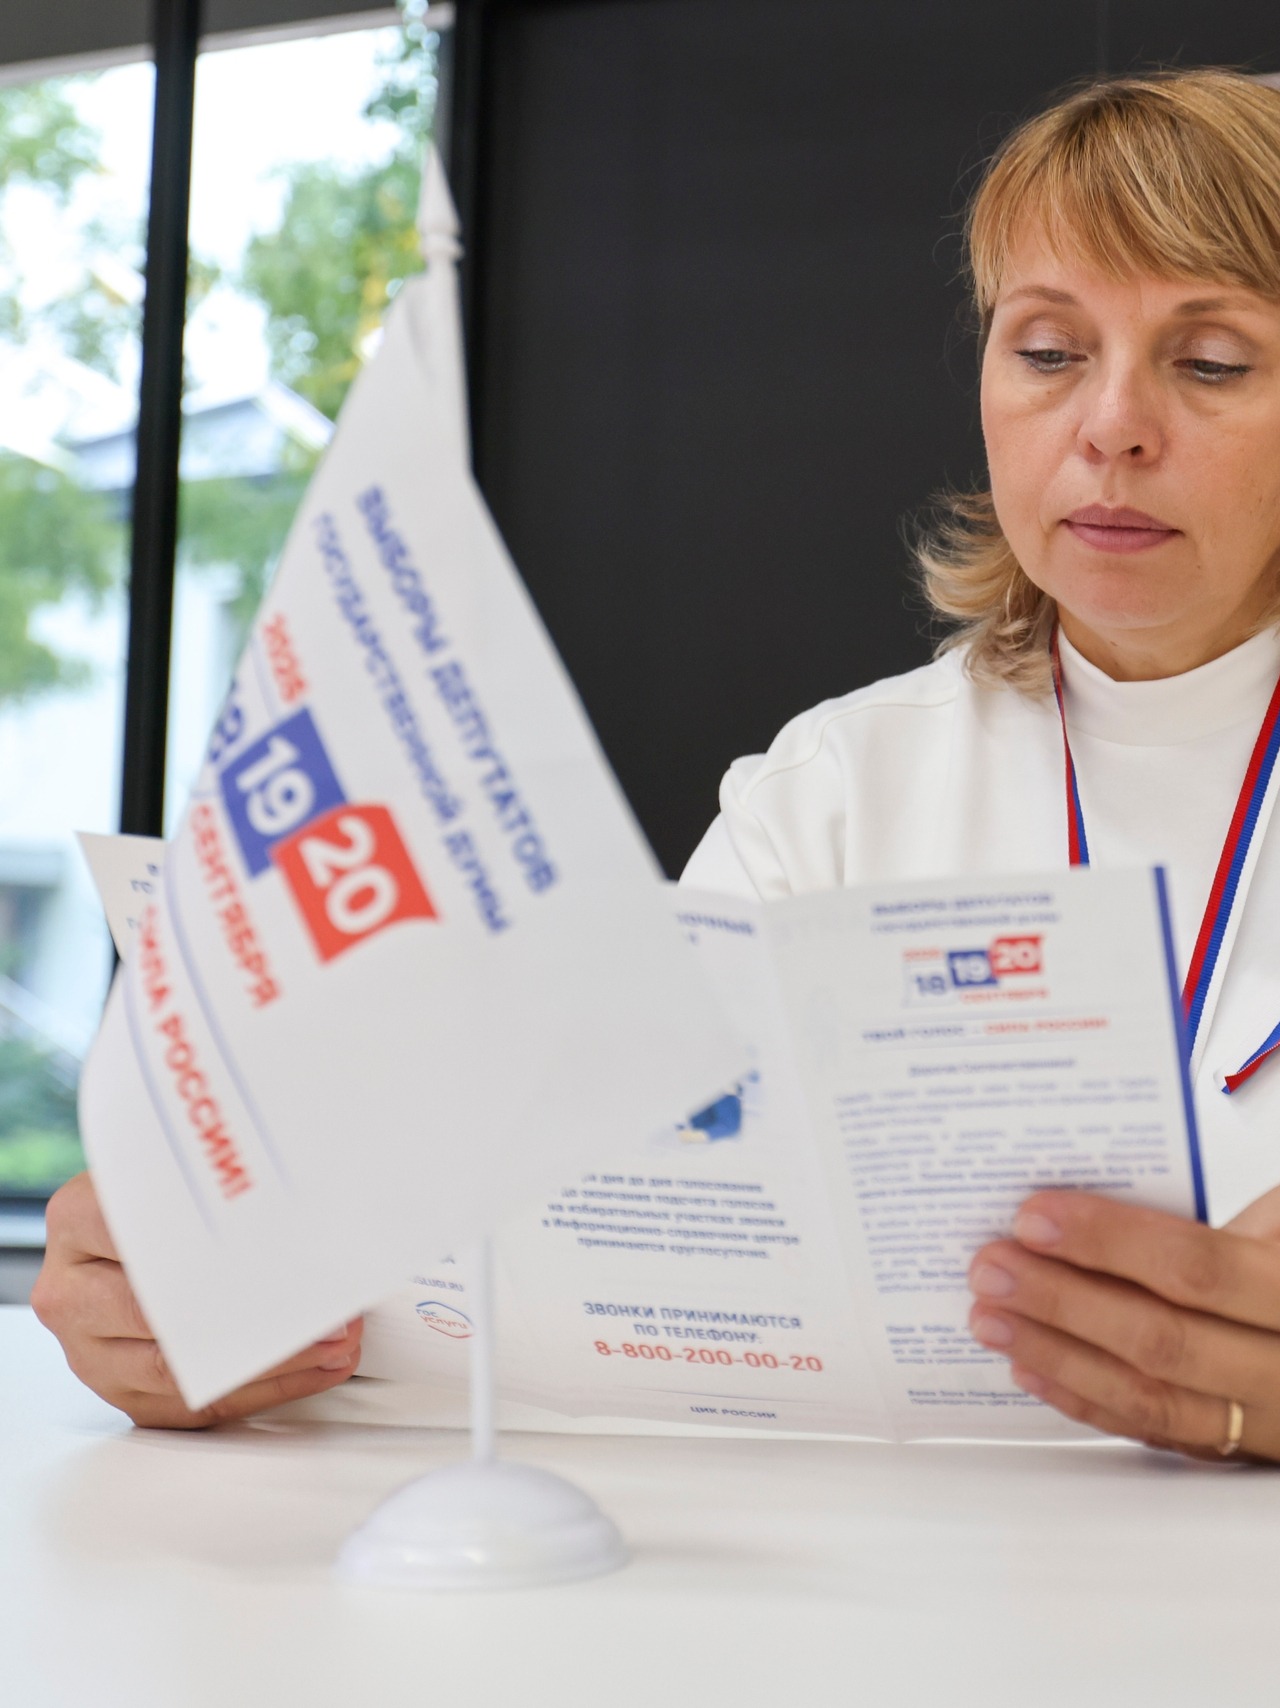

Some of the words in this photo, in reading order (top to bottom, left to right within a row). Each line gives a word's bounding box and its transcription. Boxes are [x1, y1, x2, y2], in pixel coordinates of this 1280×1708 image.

[356, 484, 450, 655] ВЫБОРЫ
[430, 659, 559, 895] ДЕПУТАТОВ
[234, 734, 316, 836] 19
[299, 813, 397, 935] 20
[442, 828, 510, 934] ДУМЫ
[996, 941, 1041, 972] 20
[915, 974, 947, 997] 18
[156, 1012, 254, 1202] РОССИИ!
[583, 1302, 655, 1319] ЗВОНКИ
[660, 1307, 803, 1331] ПРИНИМАЮТСЯ
[633, 1323, 659, 1337] ПО
[664, 1325, 764, 1345] ТЕЛЕФОНУ:
[593, 1339, 824, 1374] 8-800-200-00-20
[690, 1405, 718, 1416] ЦИК
[721, 1408, 778, 1420] РОССИИ
